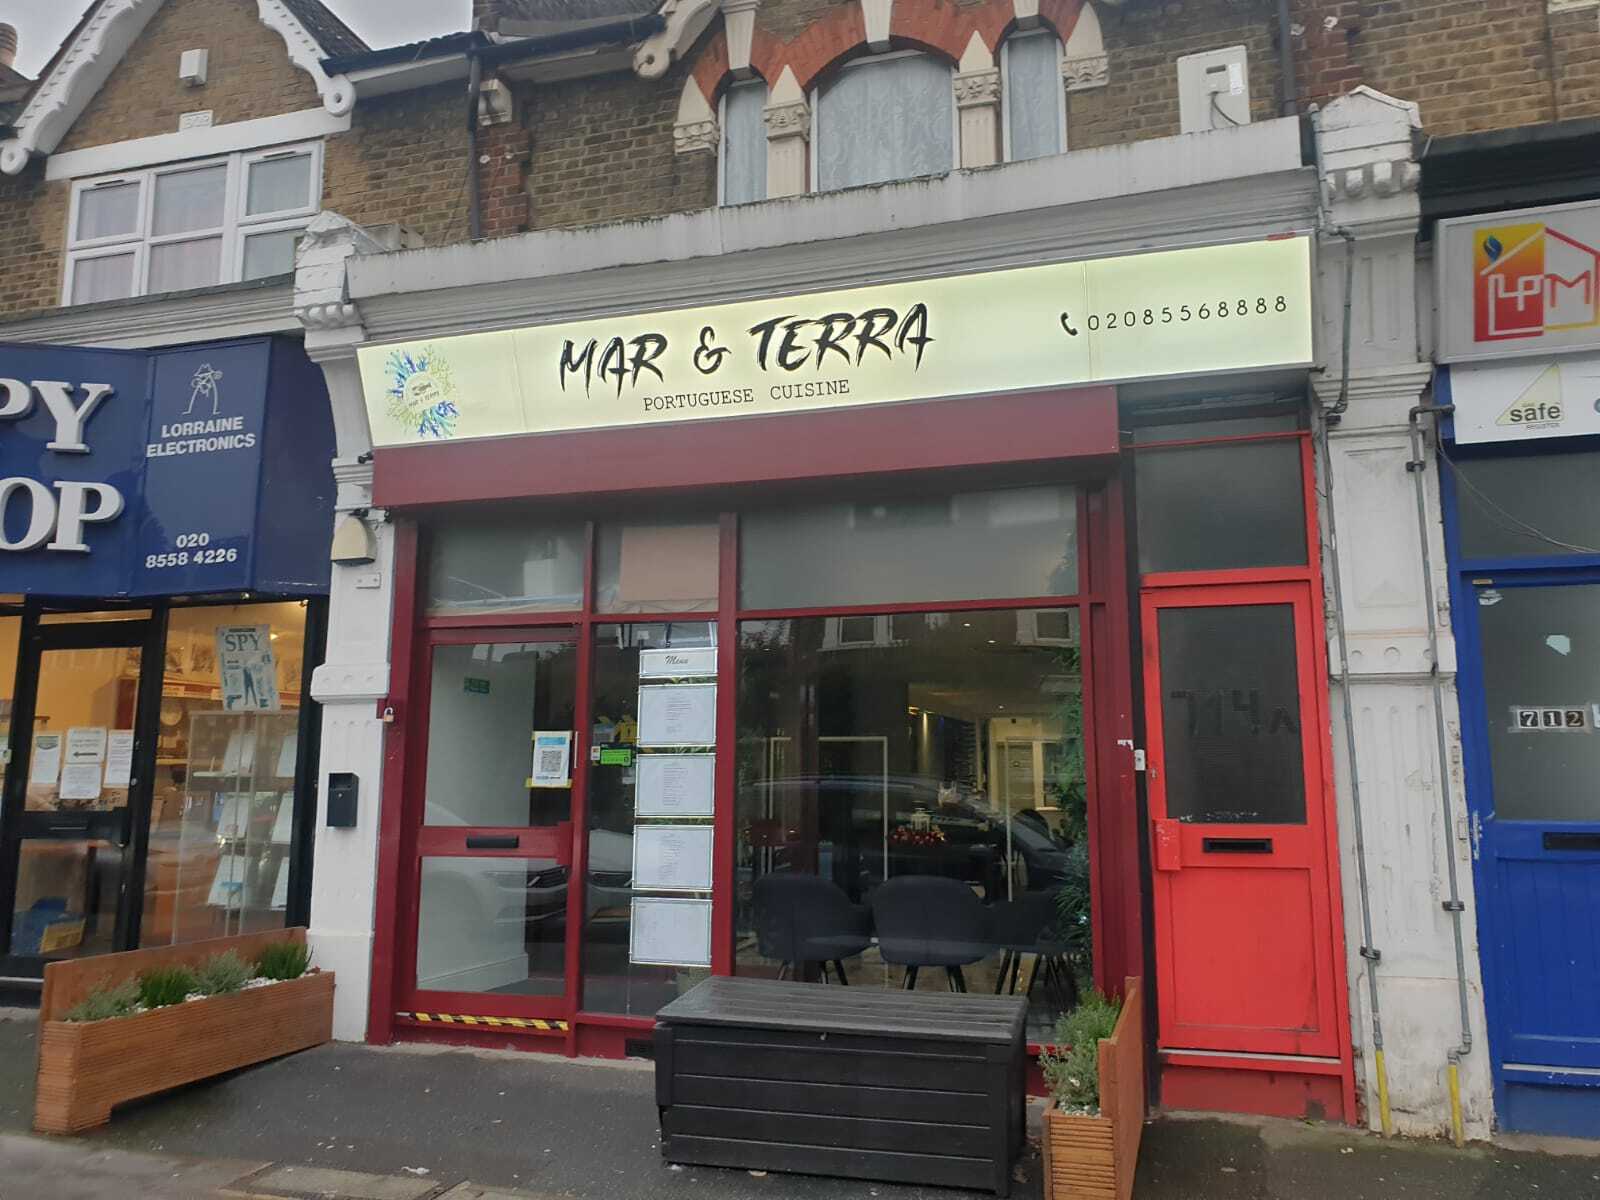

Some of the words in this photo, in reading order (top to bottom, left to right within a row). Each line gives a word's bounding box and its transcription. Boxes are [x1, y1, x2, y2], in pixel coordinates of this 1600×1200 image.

[1087, 295, 1287, 331] 02085568888
[560, 333, 668, 400] MAR
[693, 325, 732, 375] &
[746, 302, 935, 373] TERRA
[643, 388, 754, 411] PORTUGUESE
[769, 379, 851, 401] CUISINE
[1510, 402, 1561, 422] safe
[161, 416, 244, 438] LORRAINE
[146, 433, 256, 458] ELECTRONICS
[0, 477, 124, 552] OP
[176, 533, 209, 548] 020
[145, 551, 188, 568] 8558
[193, 548, 238, 564] 4226
[225, 633, 262, 652] SPY
[1520, 710, 1583, 728] 712
